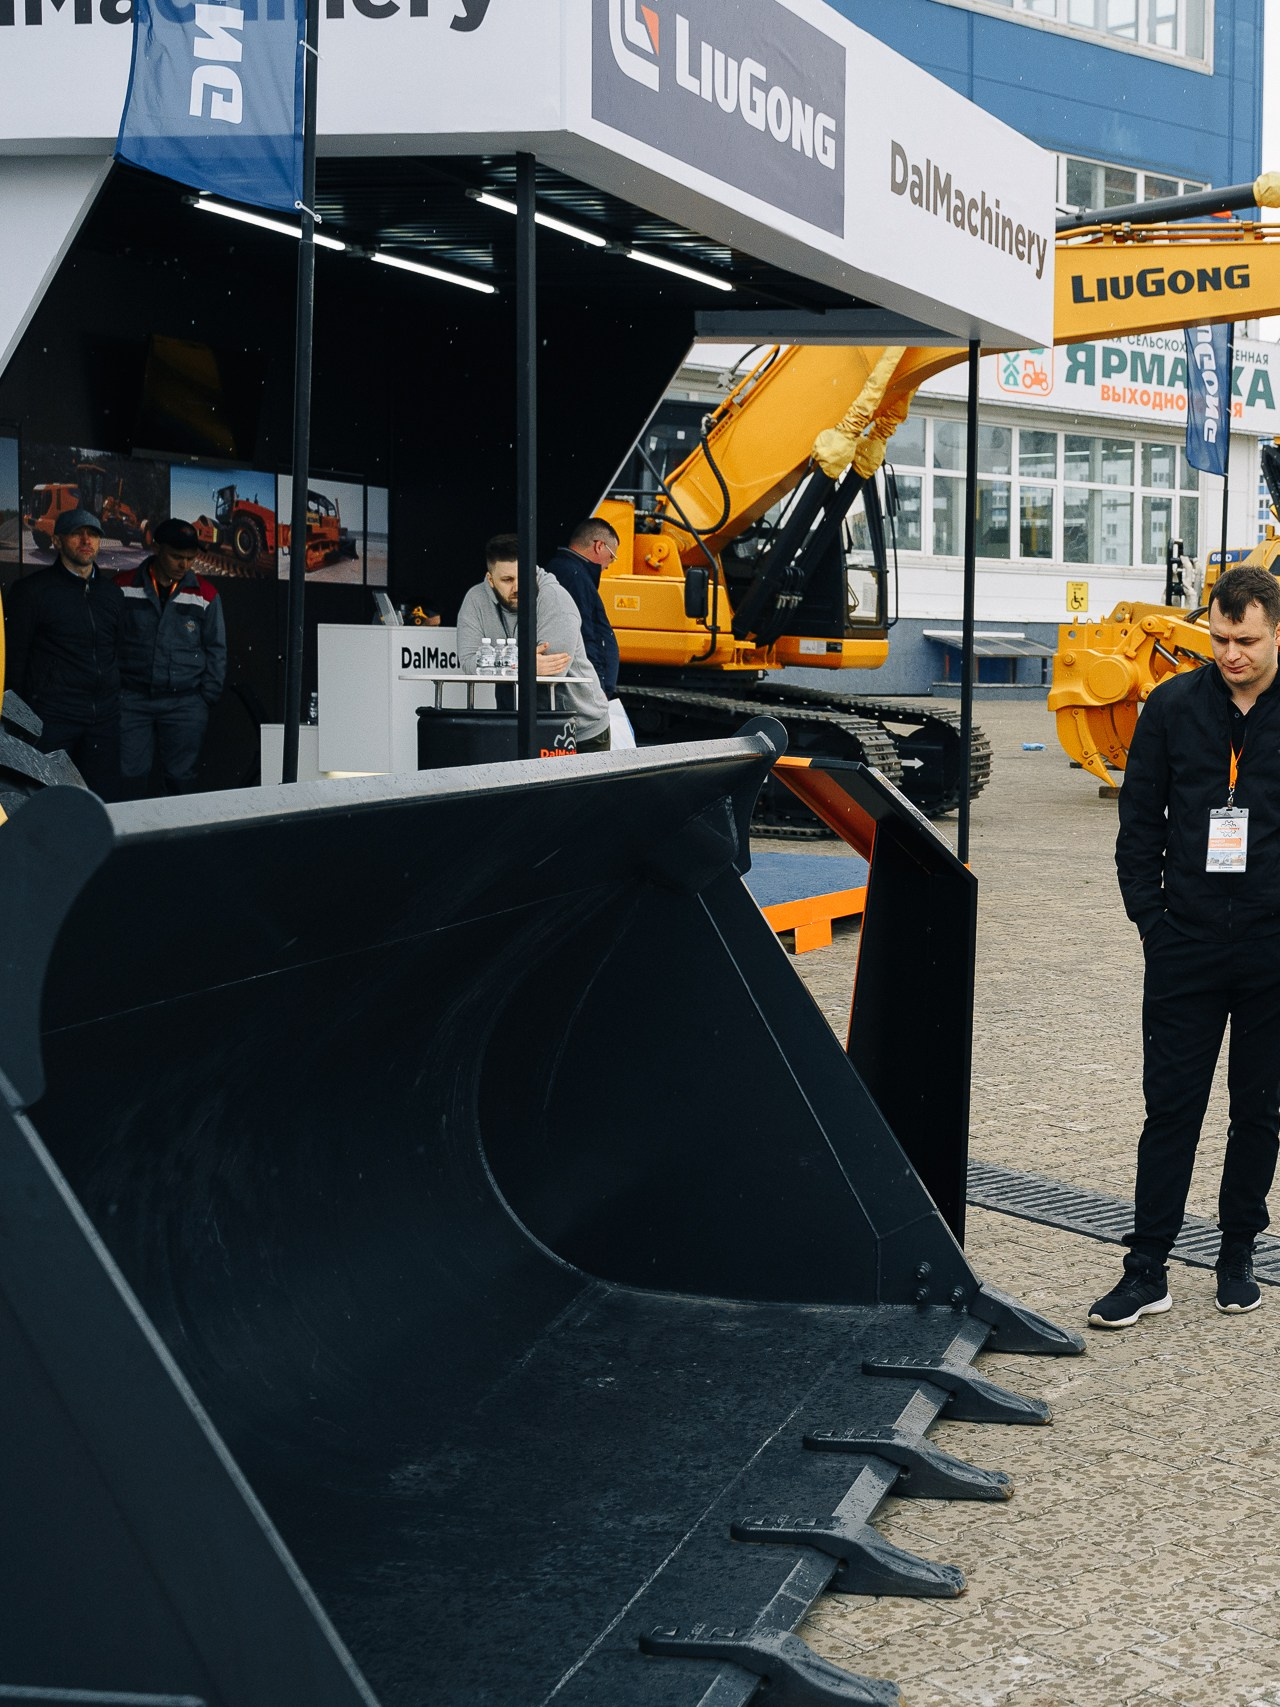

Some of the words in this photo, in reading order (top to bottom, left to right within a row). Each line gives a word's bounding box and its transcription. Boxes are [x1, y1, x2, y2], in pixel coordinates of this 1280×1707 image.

[890, 139, 1048, 280] DalMachinery
[1065, 341, 1276, 410] ЯРМАКА
[1101, 383, 1187, 412] ВЫХОДНО
[401, 645, 461, 669] DalMac
